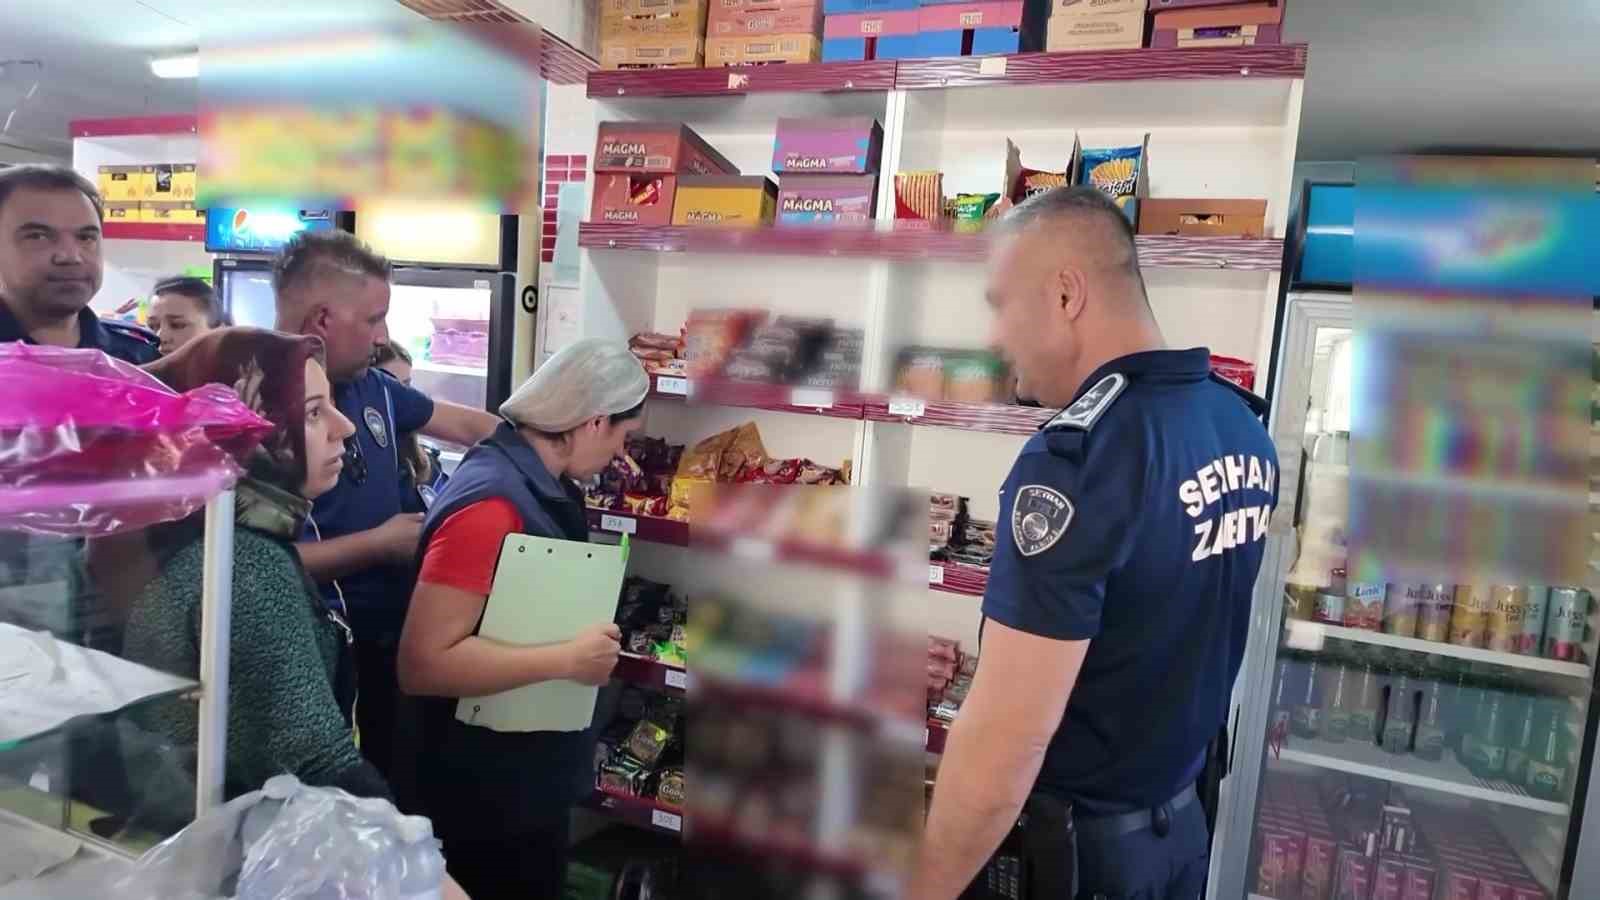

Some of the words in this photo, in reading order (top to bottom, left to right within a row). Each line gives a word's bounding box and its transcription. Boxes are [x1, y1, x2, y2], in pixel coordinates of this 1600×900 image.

[603, 143, 646, 155] MAGMA
[786, 158, 827, 169] MAGMA
[783, 199, 833, 212] MAGMA
[604, 210, 639, 221] MAGMA
[687, 211, 722, 222] MAGMA
